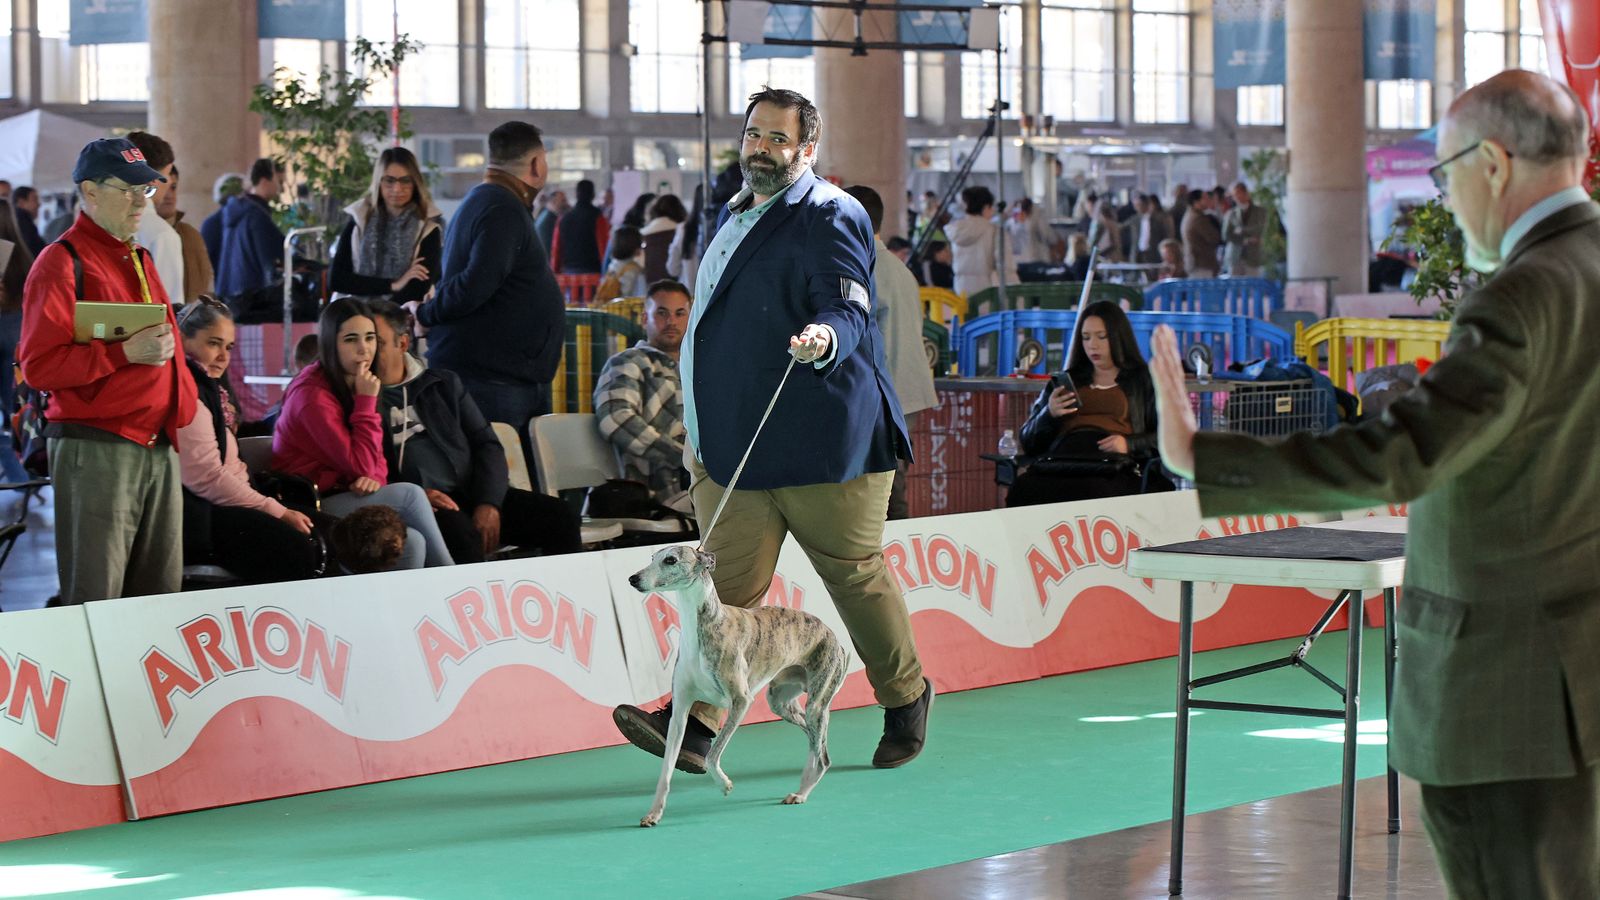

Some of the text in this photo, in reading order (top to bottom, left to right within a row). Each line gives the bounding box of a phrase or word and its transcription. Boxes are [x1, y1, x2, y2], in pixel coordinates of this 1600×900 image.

[120, 147, 147, 163] US
[881, 533, 998, 617] RION
[140, 606, 352, 738] ARION
[413, 580, 597, 701] ARION
